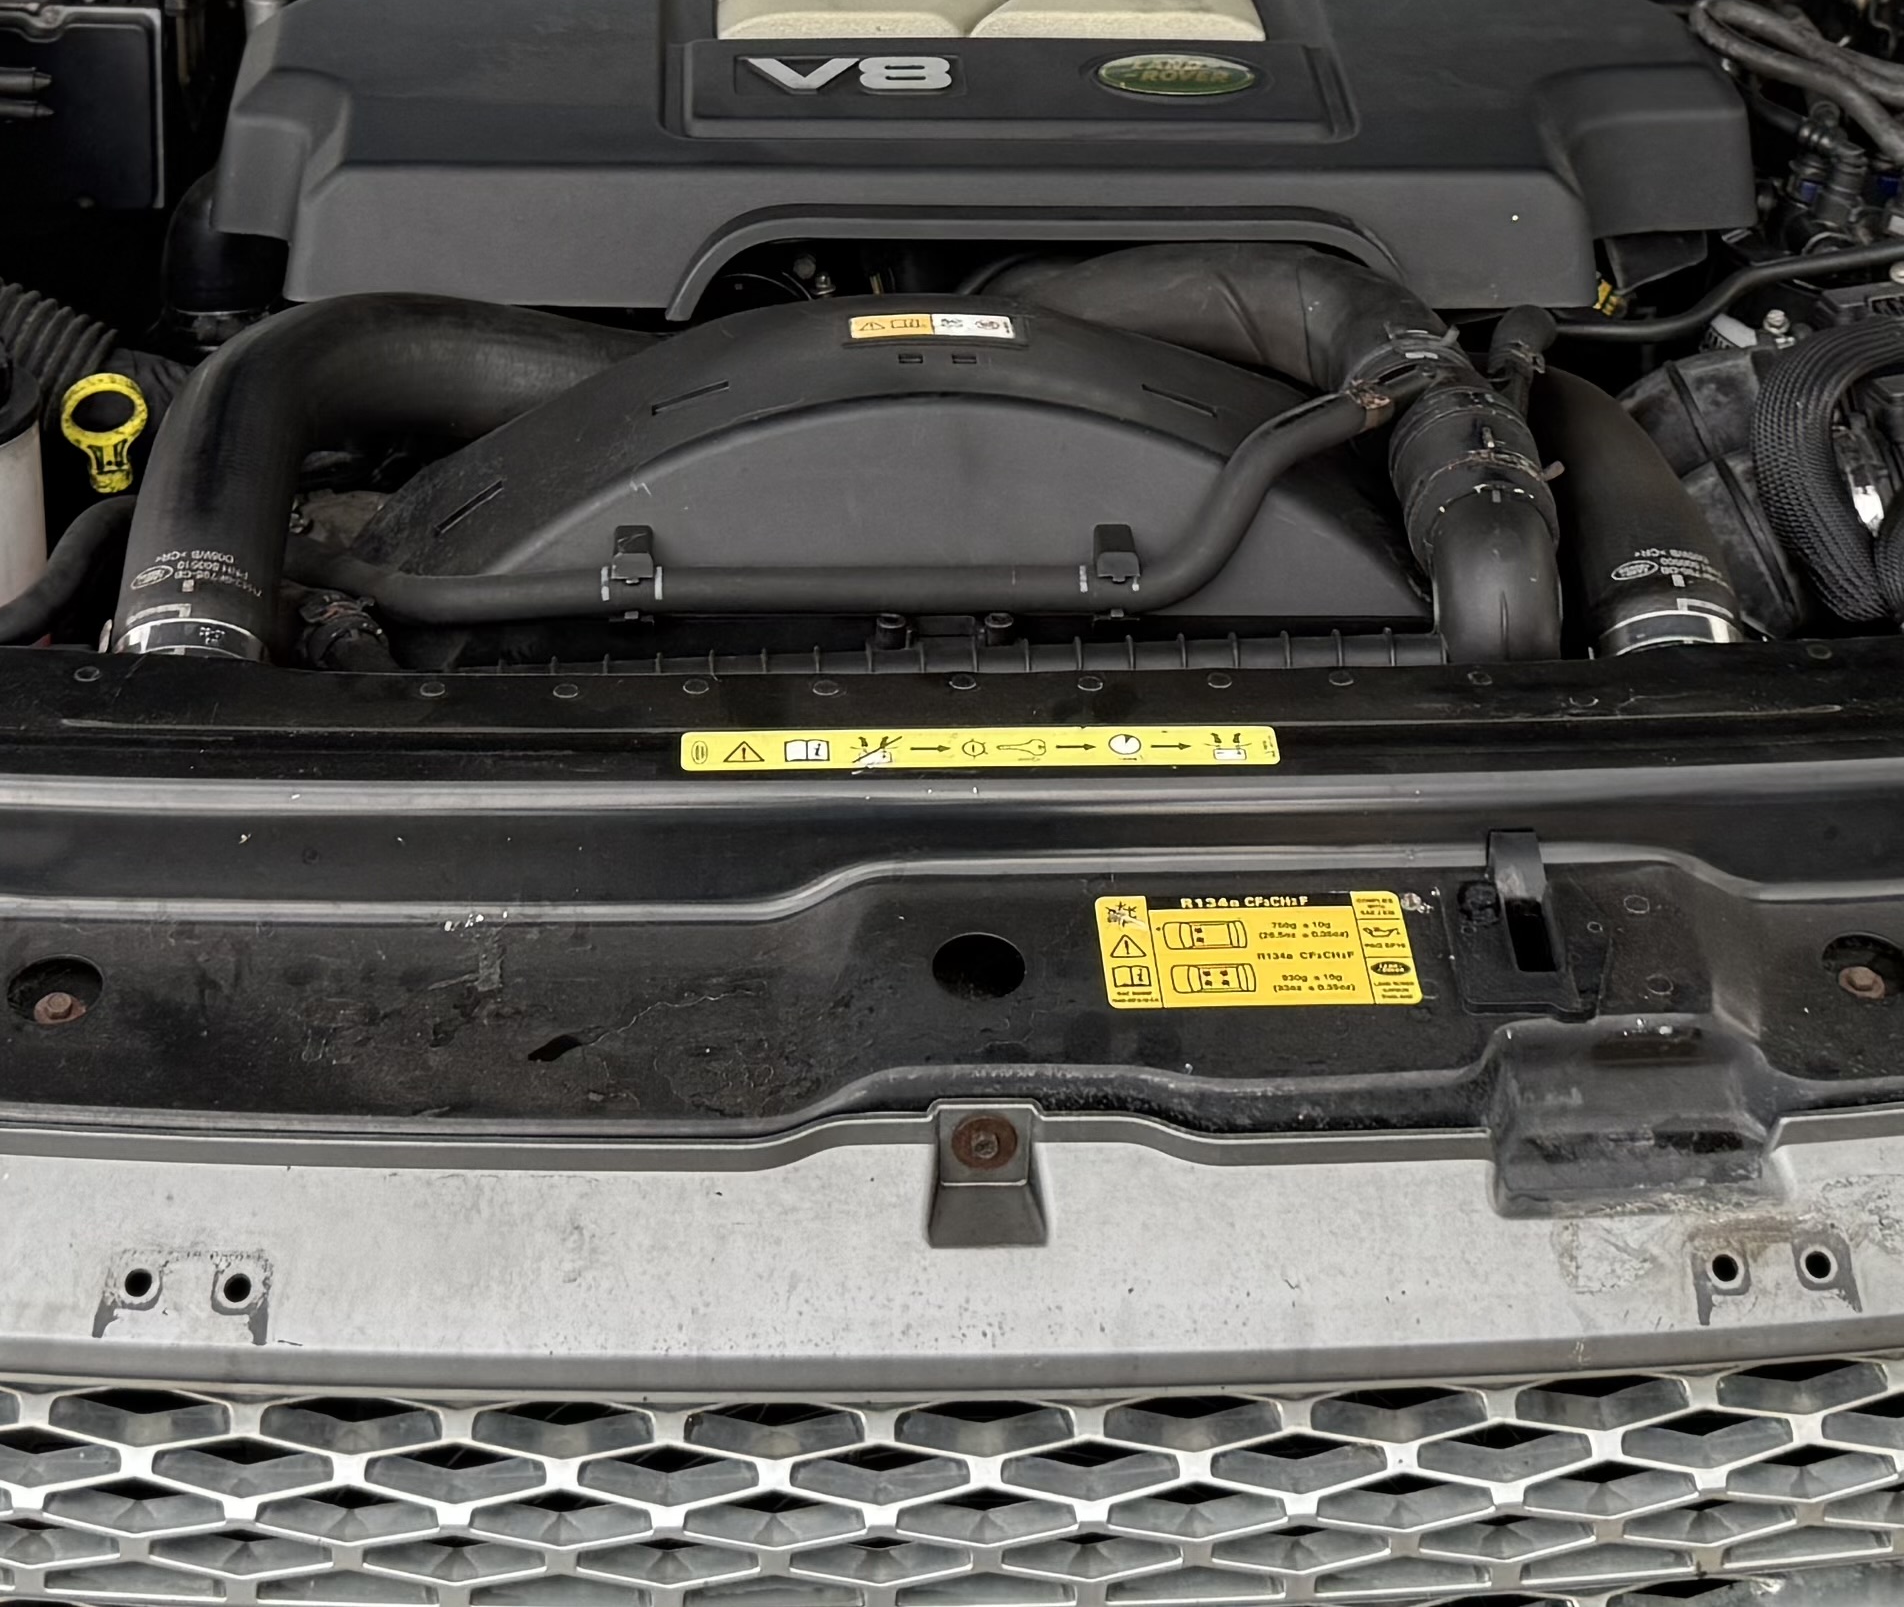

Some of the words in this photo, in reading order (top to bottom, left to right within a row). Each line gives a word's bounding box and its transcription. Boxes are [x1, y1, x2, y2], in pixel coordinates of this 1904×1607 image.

[746, 56, 953, 91] V8
[1140, 70, 1230, 82] ROVER
[1180, 897, 1240, 909] R134a
